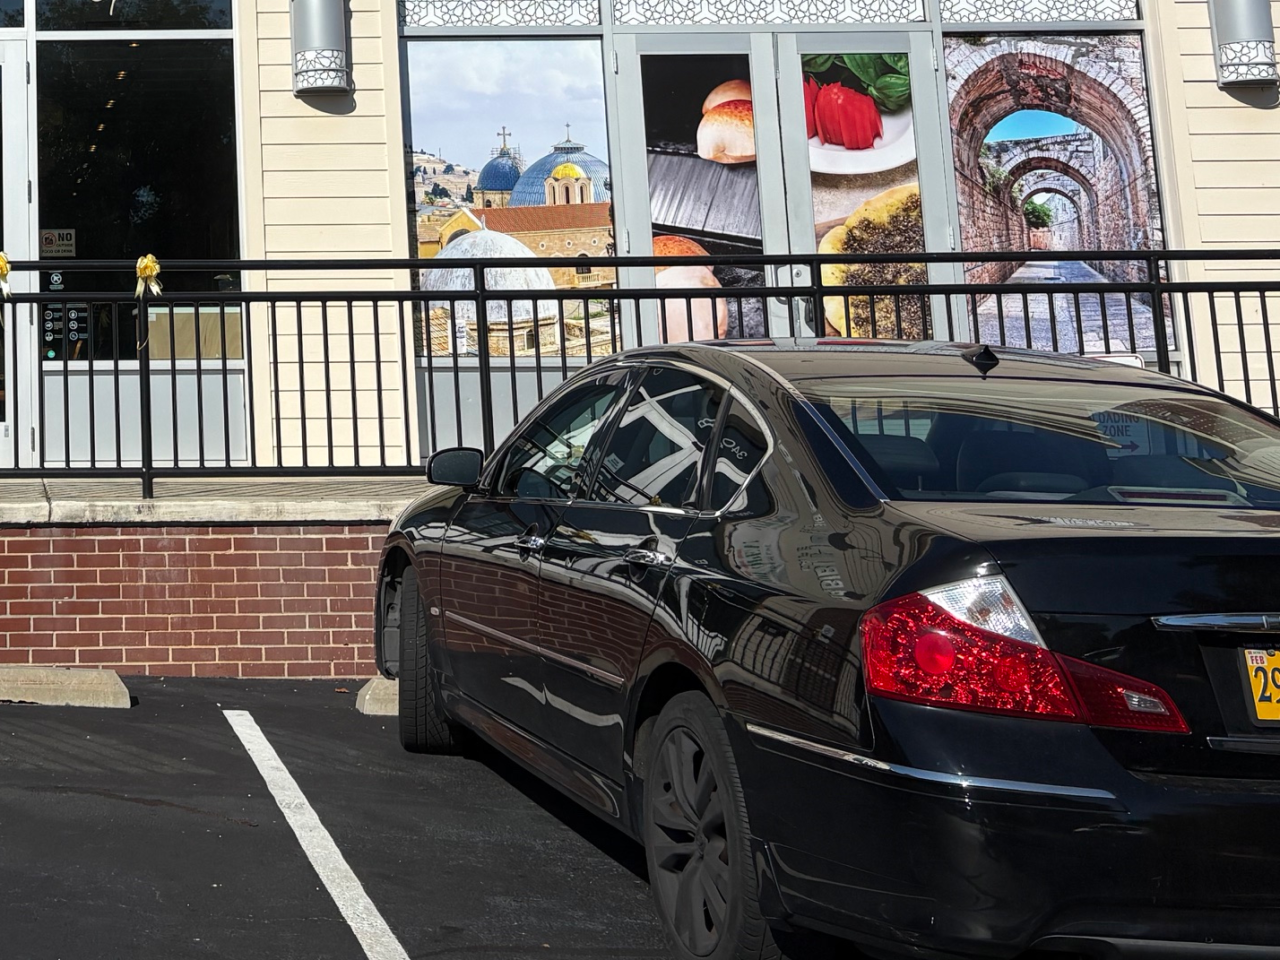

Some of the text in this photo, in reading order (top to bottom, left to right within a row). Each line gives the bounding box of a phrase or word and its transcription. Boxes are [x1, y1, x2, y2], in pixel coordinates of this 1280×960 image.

[57, 232, 73, 242] NO
[1102, 424, 1132, 438] ZONE
[1249, 655, 1265, 665] FEB
